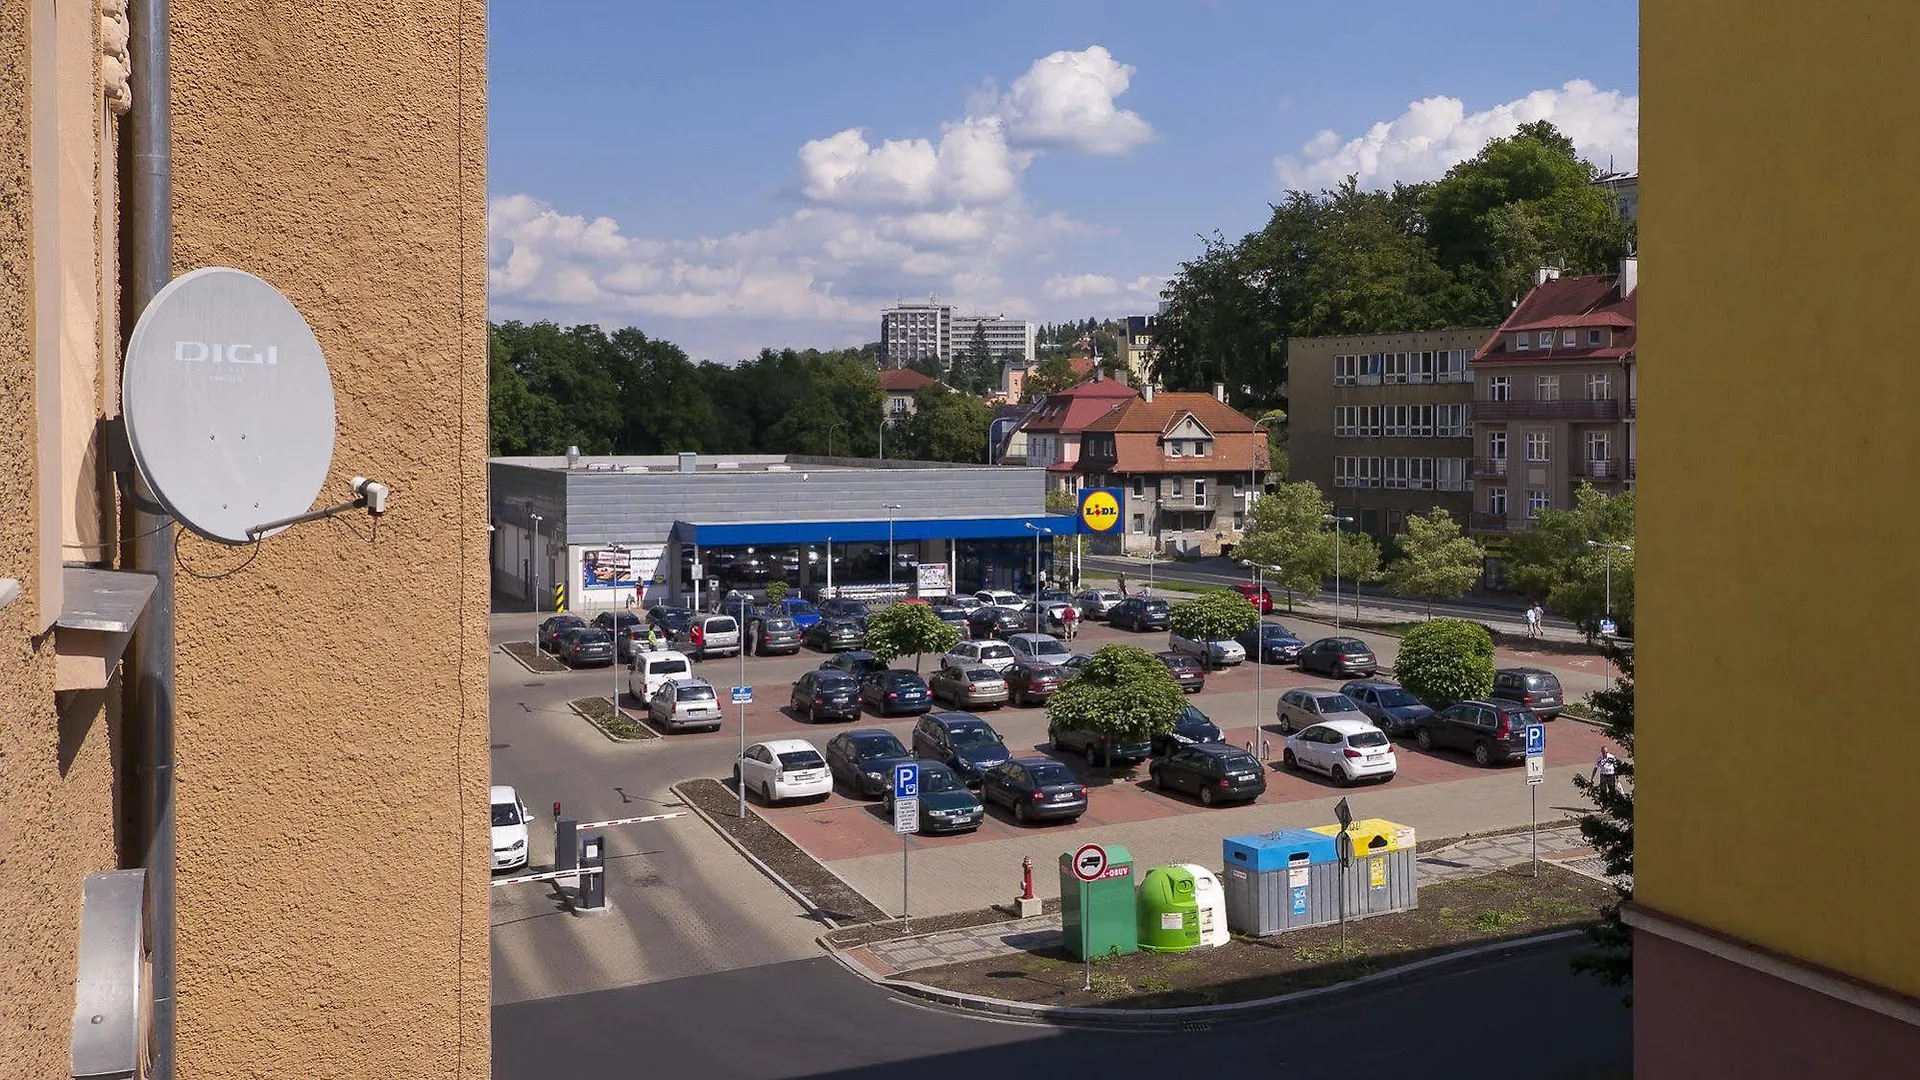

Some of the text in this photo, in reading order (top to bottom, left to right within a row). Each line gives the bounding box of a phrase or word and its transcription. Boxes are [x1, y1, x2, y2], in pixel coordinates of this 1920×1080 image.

[175, 341, 278, 365] DIGI
[1529, 727, 1541, 747] P
[899, 768, 914, 789] P
